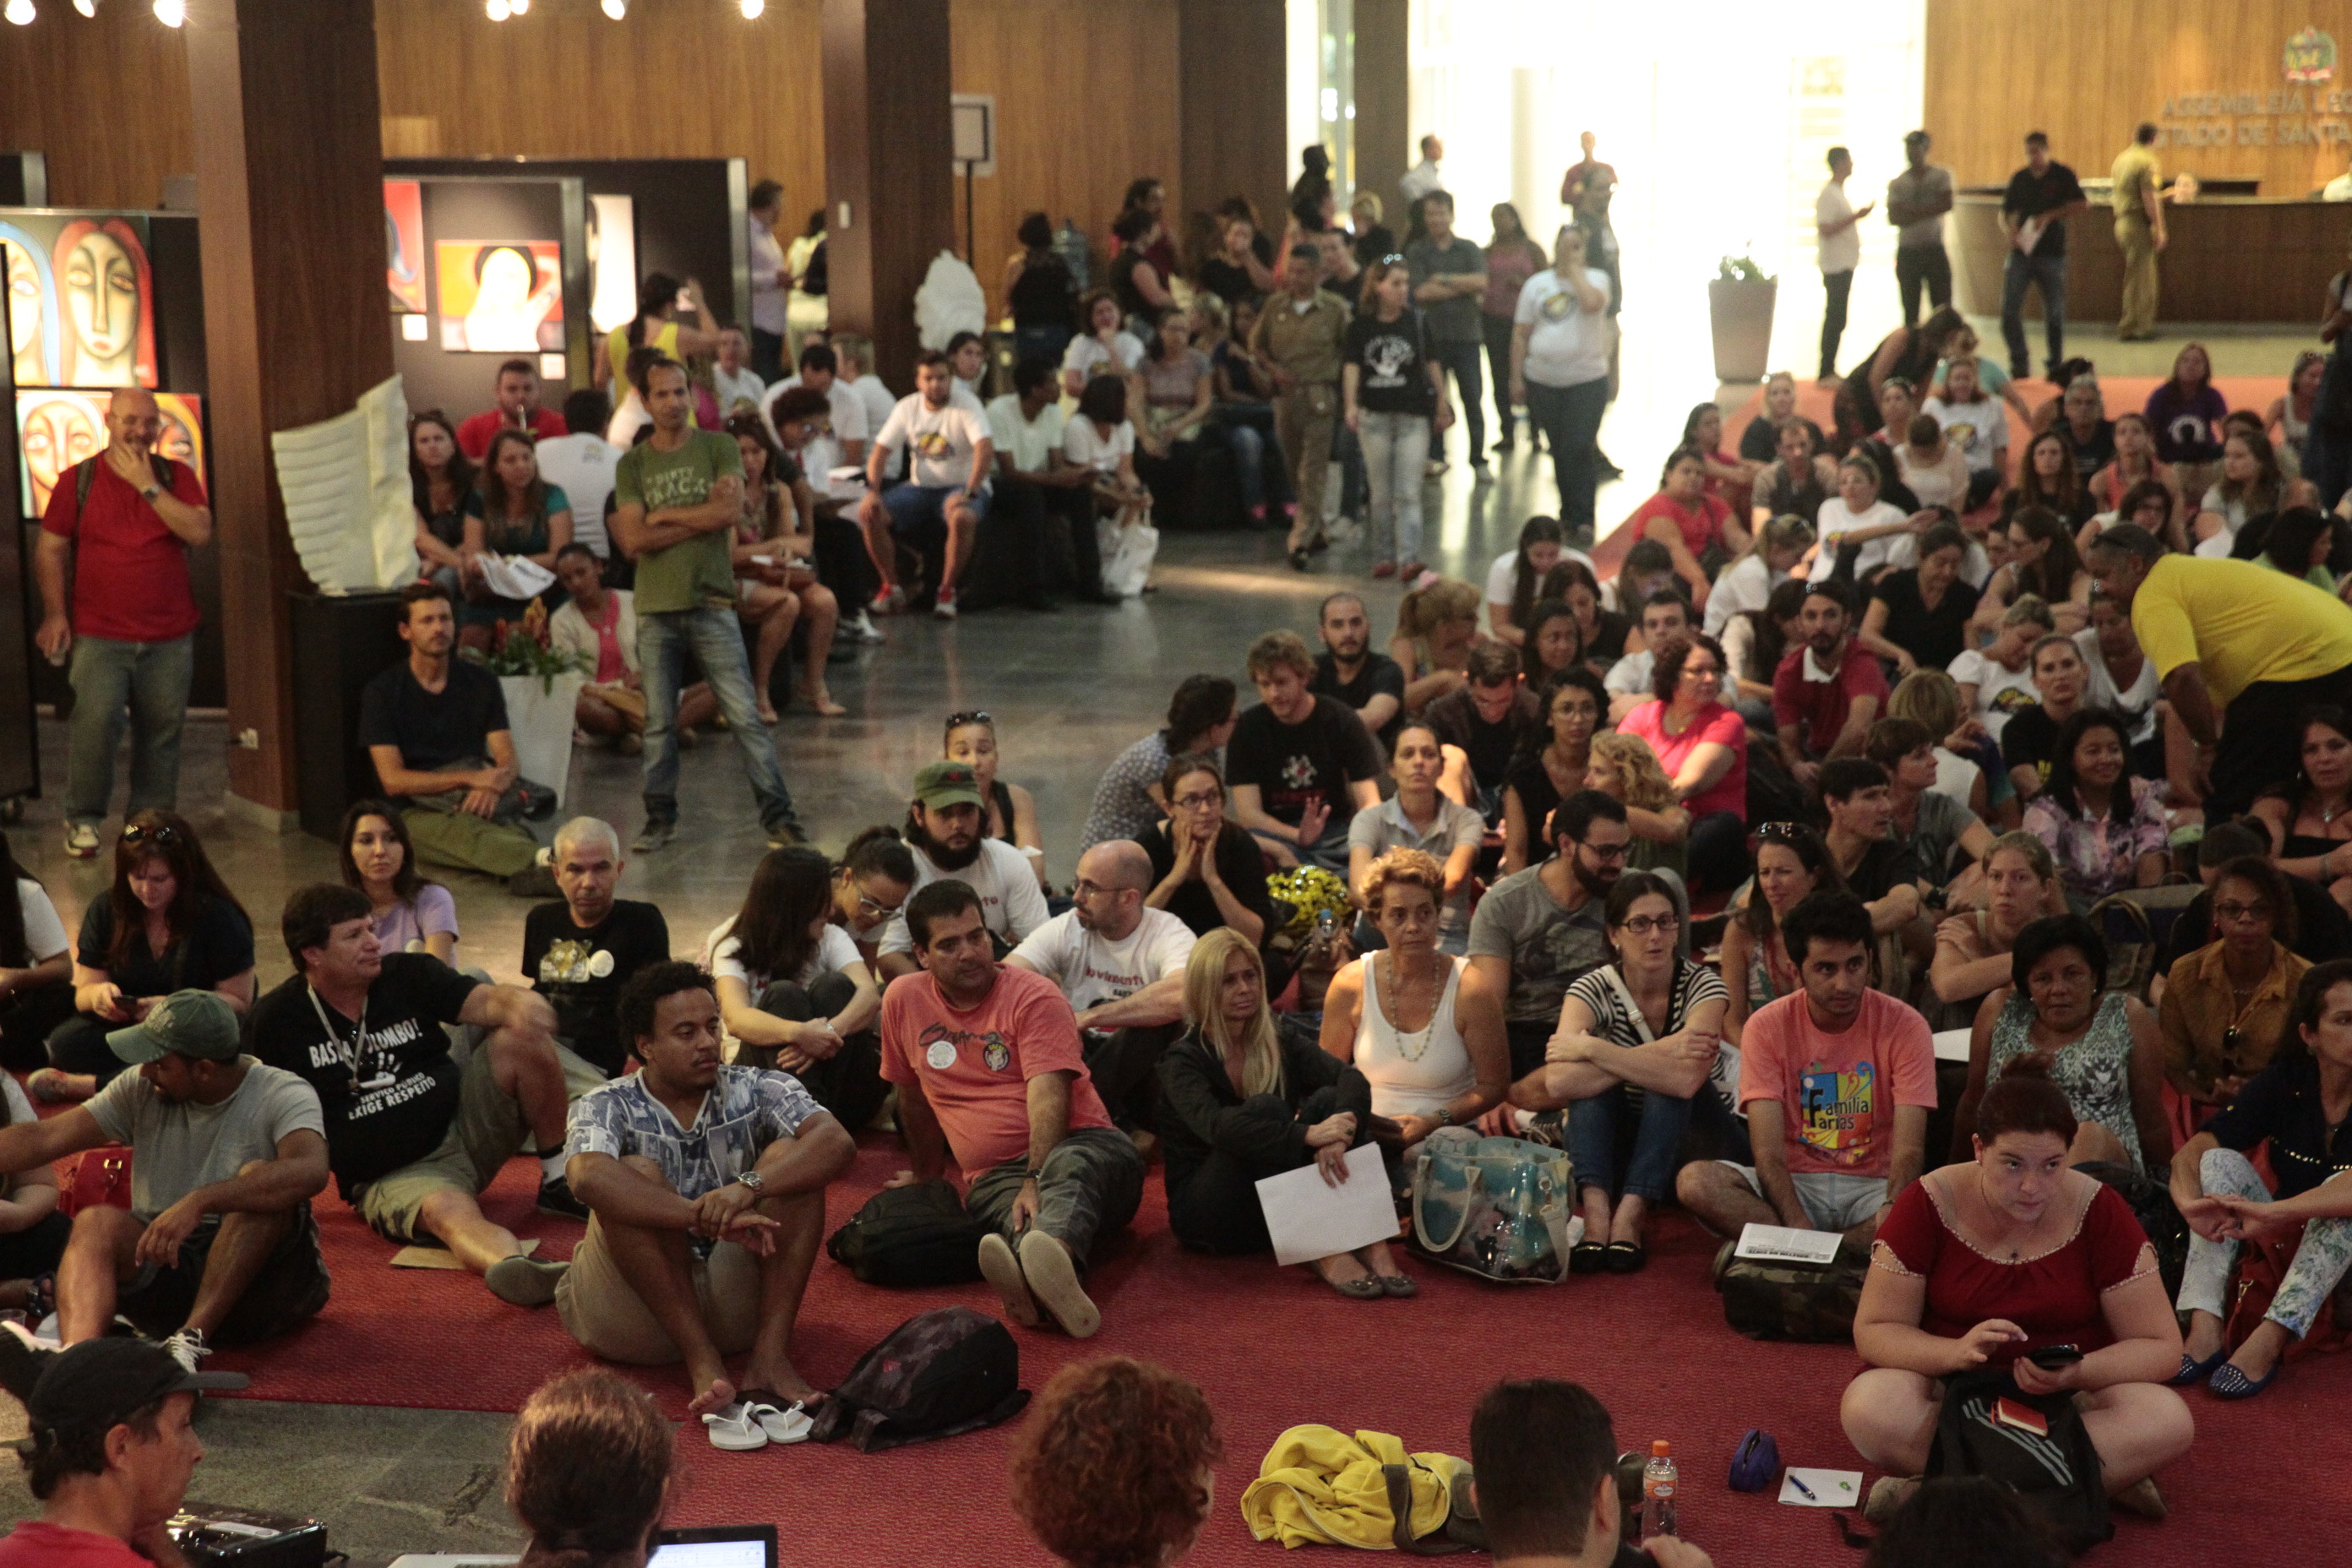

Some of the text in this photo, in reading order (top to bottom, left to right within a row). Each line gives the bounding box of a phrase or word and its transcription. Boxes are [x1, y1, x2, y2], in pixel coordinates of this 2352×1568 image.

[2154, 122, 2233, 149] STADO
[2239, 120, 2269, 146] DE
[348, 1075, 436, 1120] EXIGE RESPEITO
